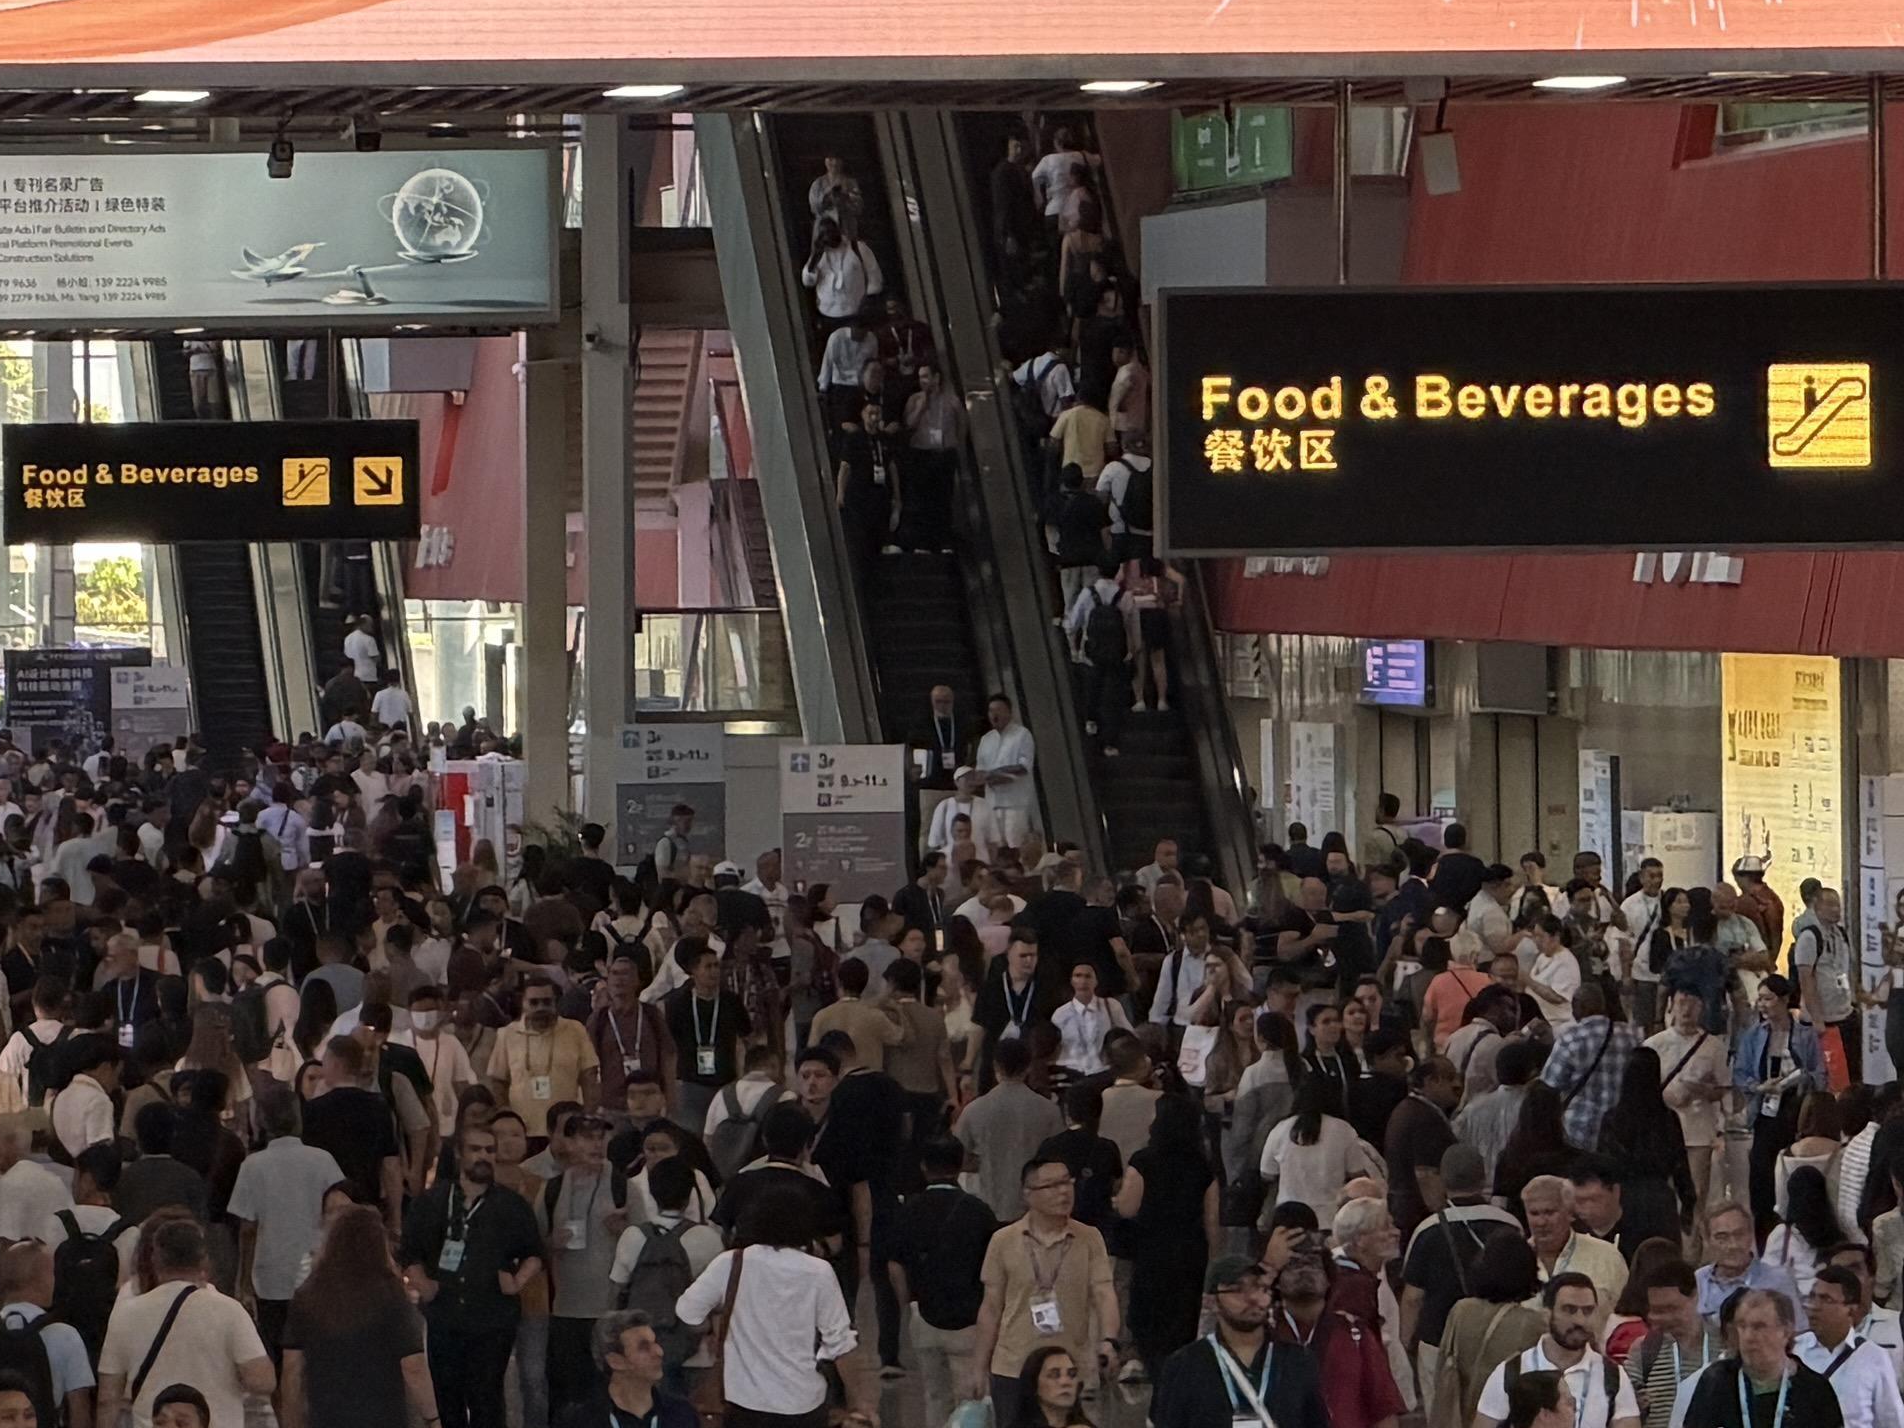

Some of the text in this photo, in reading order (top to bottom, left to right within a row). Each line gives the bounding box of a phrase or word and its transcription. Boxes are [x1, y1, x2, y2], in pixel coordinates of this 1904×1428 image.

[13, 176, 104, 193] 专刊名录广告
[1201, 374, 1715, 427] Food & Beverages
[1205, 429, 1339, 473] 餐饮区
[22, 463, 260, 490] Food & Beverages
[24, 488, 86, 510] 餐饮区
